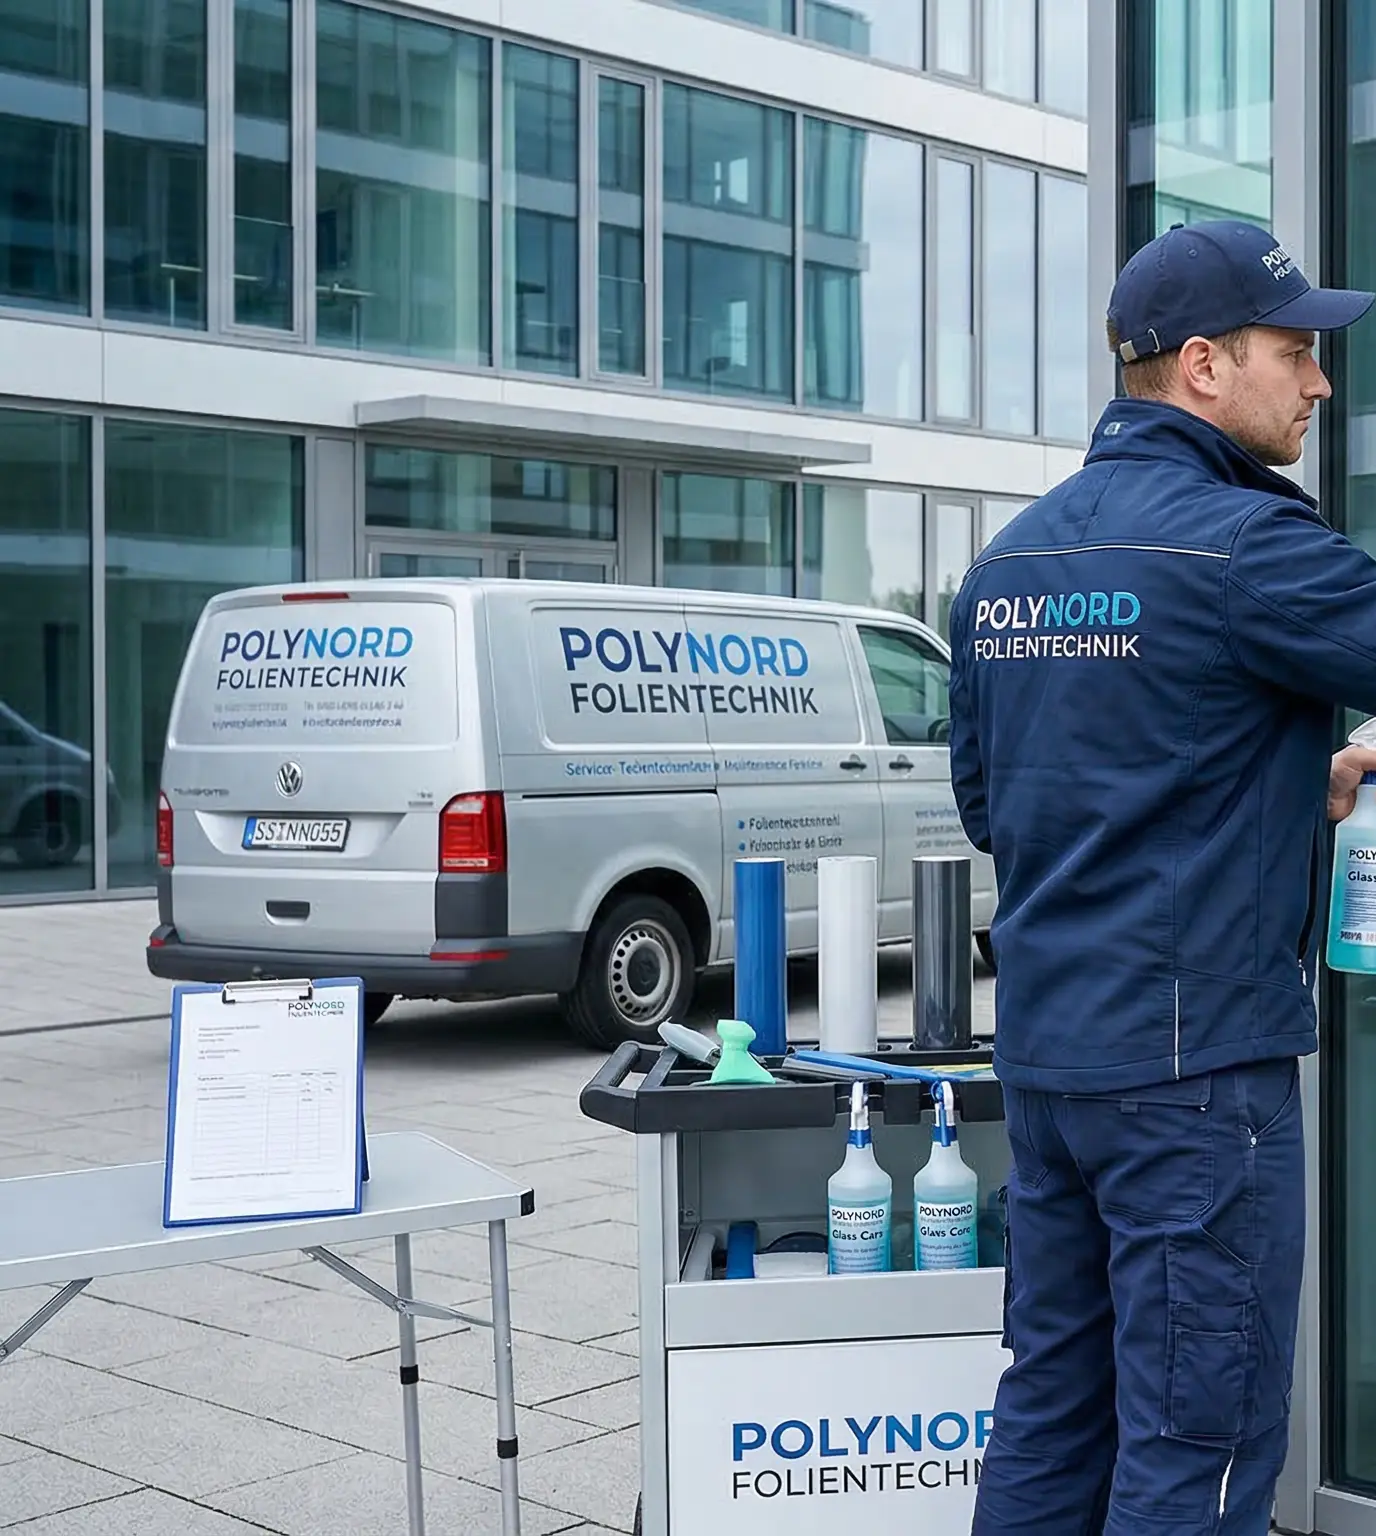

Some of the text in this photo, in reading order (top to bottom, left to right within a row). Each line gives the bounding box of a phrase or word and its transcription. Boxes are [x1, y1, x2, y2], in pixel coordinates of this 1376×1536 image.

[975, 592, 1141, 631] POLYNORD
[221, 627, 413, 663] POLYNORD
[559, 627, 809, 677] POLYNORD
[974, 635, 1141, 661] FOLIENTECHNIK
[216, 666, 408, 690] FOLIENTECHNIK
[570, 682, 820, 714] FOLIENTECHNIK
[832, 1229, 857, 1240] Glass
